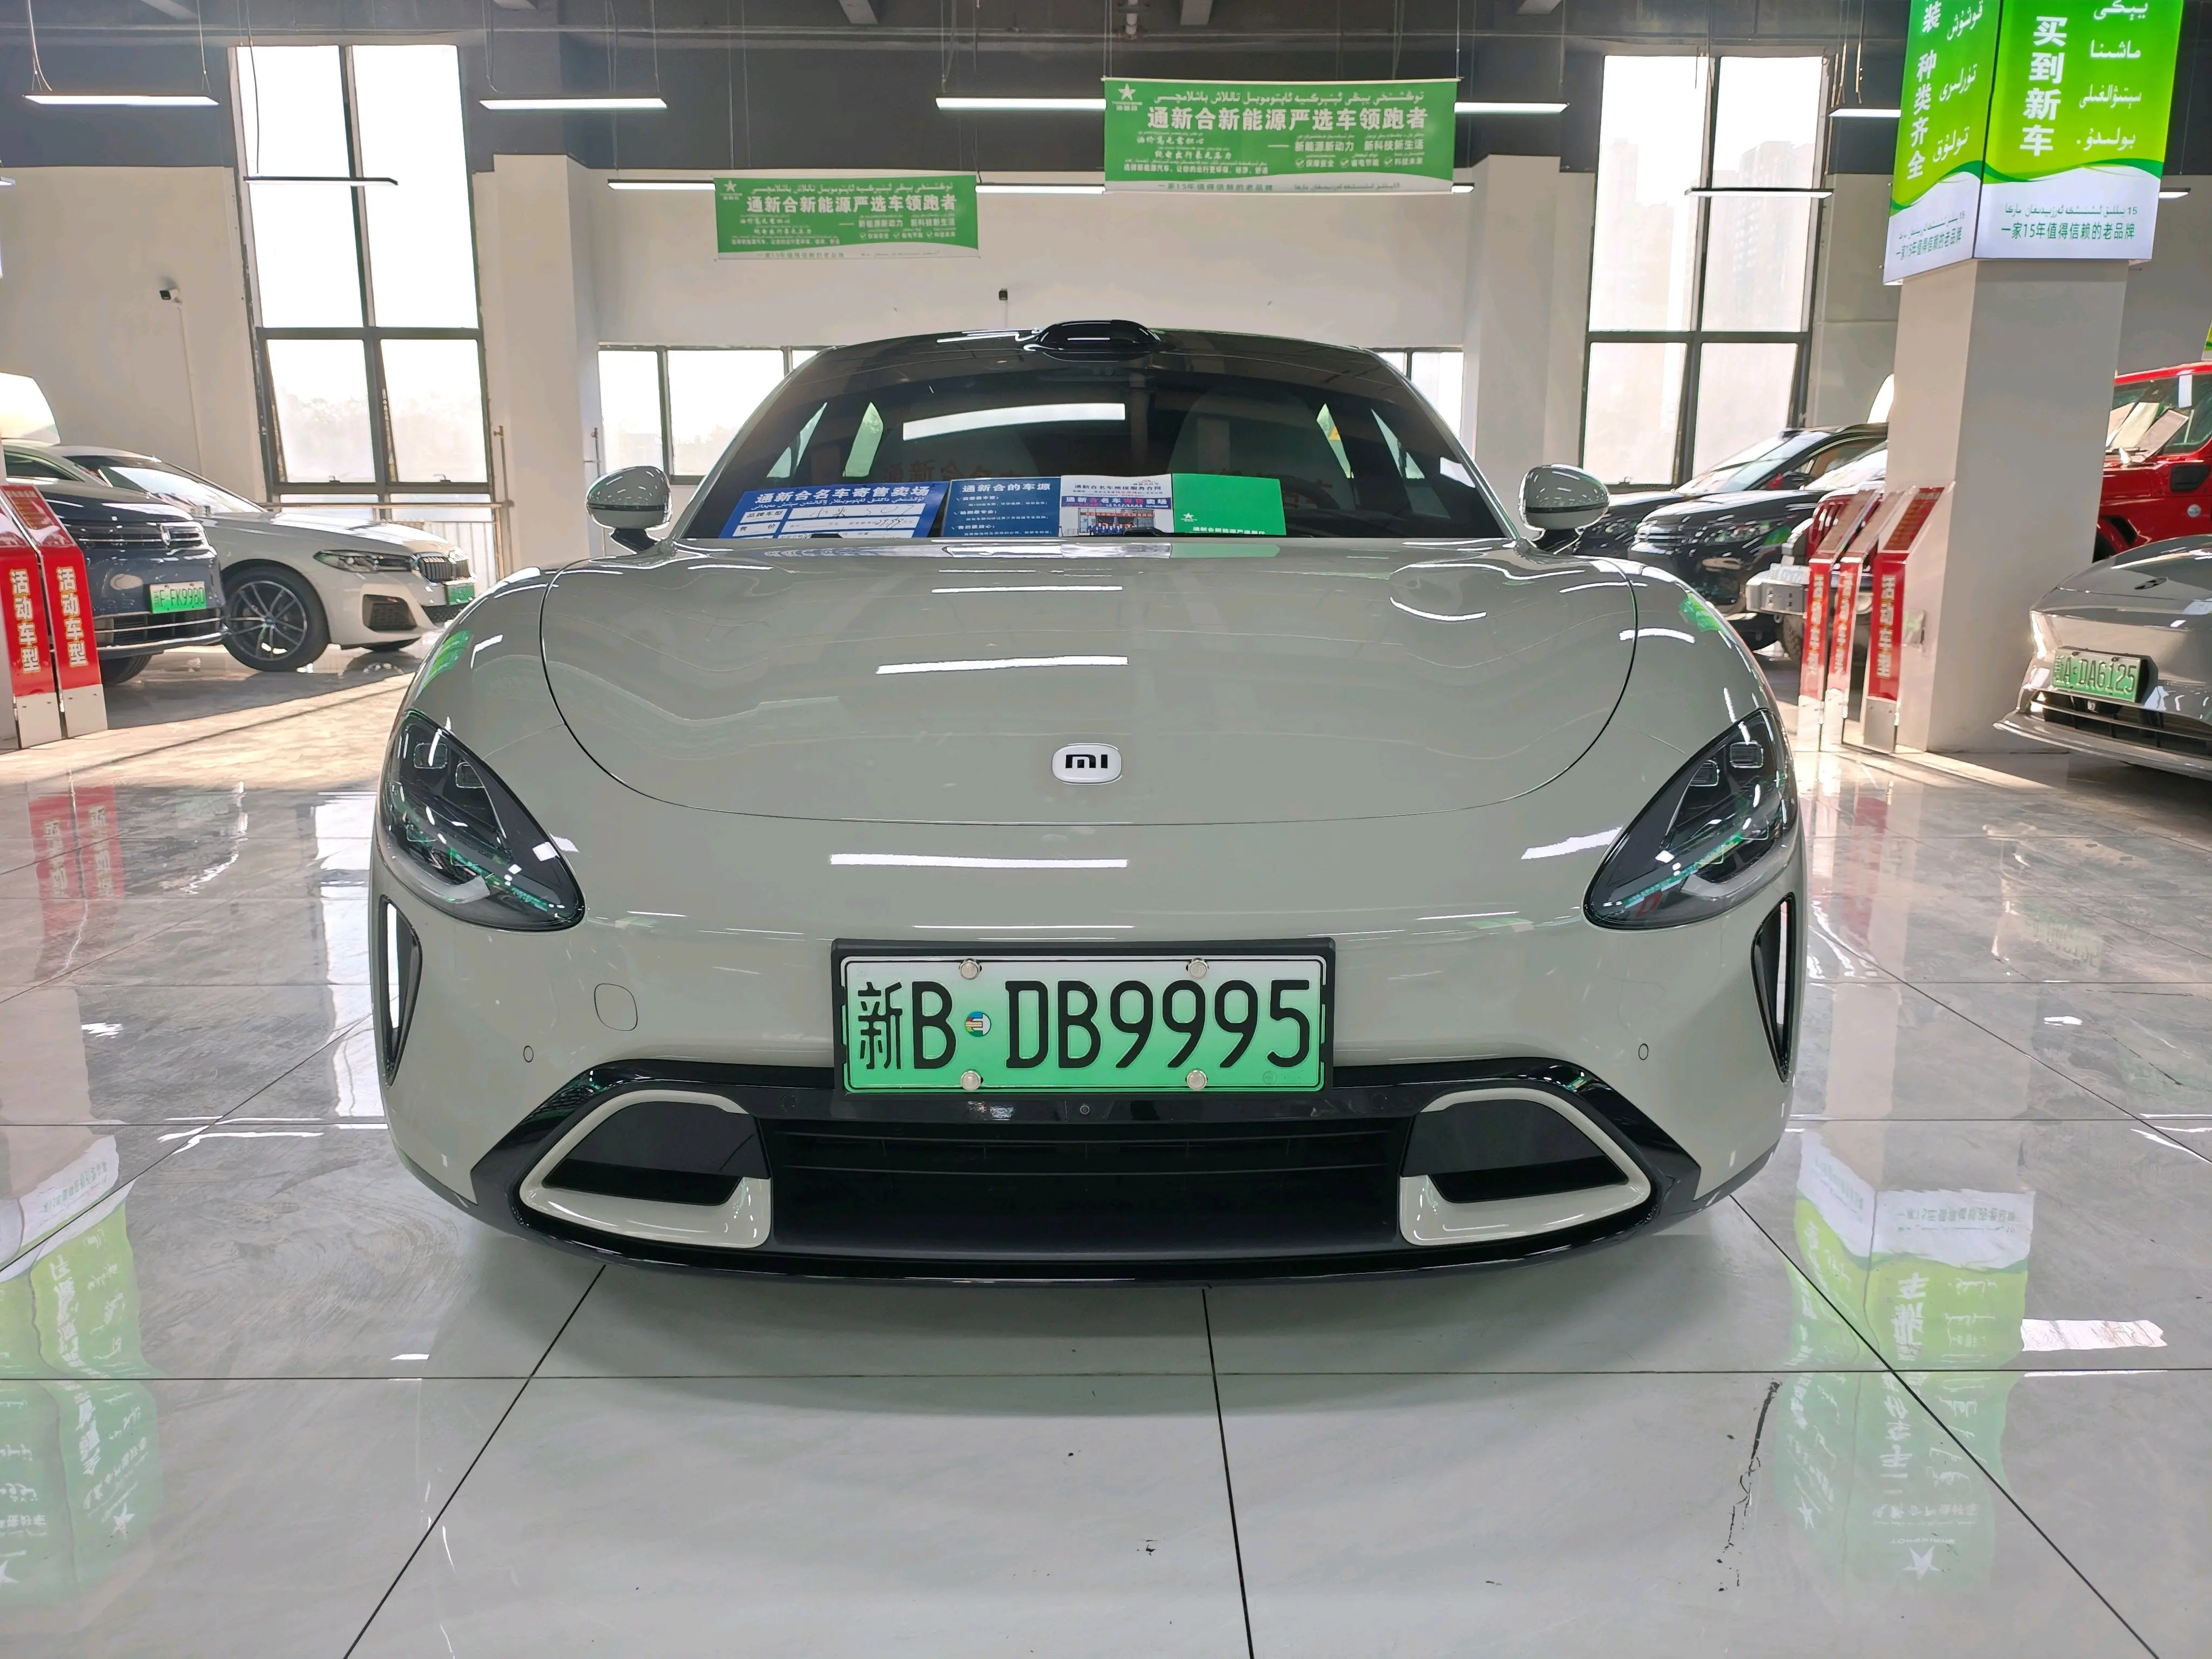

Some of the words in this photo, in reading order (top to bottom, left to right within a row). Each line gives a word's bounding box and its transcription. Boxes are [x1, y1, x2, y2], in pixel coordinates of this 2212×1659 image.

[2090, 39, 2141, 58] ماشىنا
[2020, 16, 2068, 157] 买到新车
[1147, 106, 1428, 131] 通新合新能源严选车领跑者
[1906, 49, 1938, 180] 种类齐全
[746, 193, 957, 213] 通新合新能源严选车领跑者
[2127, 207, 2138, 215] 15
[2001, 221, 2135, 240] 一家15年值得信赖的老品牌
[755, 486, 930, 504] 通新合名车寄售卖场
[962, 483, 1051, 493] 通新合的车源
[9, 568, 42, 674] 活动车型
[56, 566, 89, 667] 活动车型
[2078, 658, 2137, 694] DA6125
[858, 979, 956, 1070] 新B
[1004, 979, 1311, 1070] DB9995
